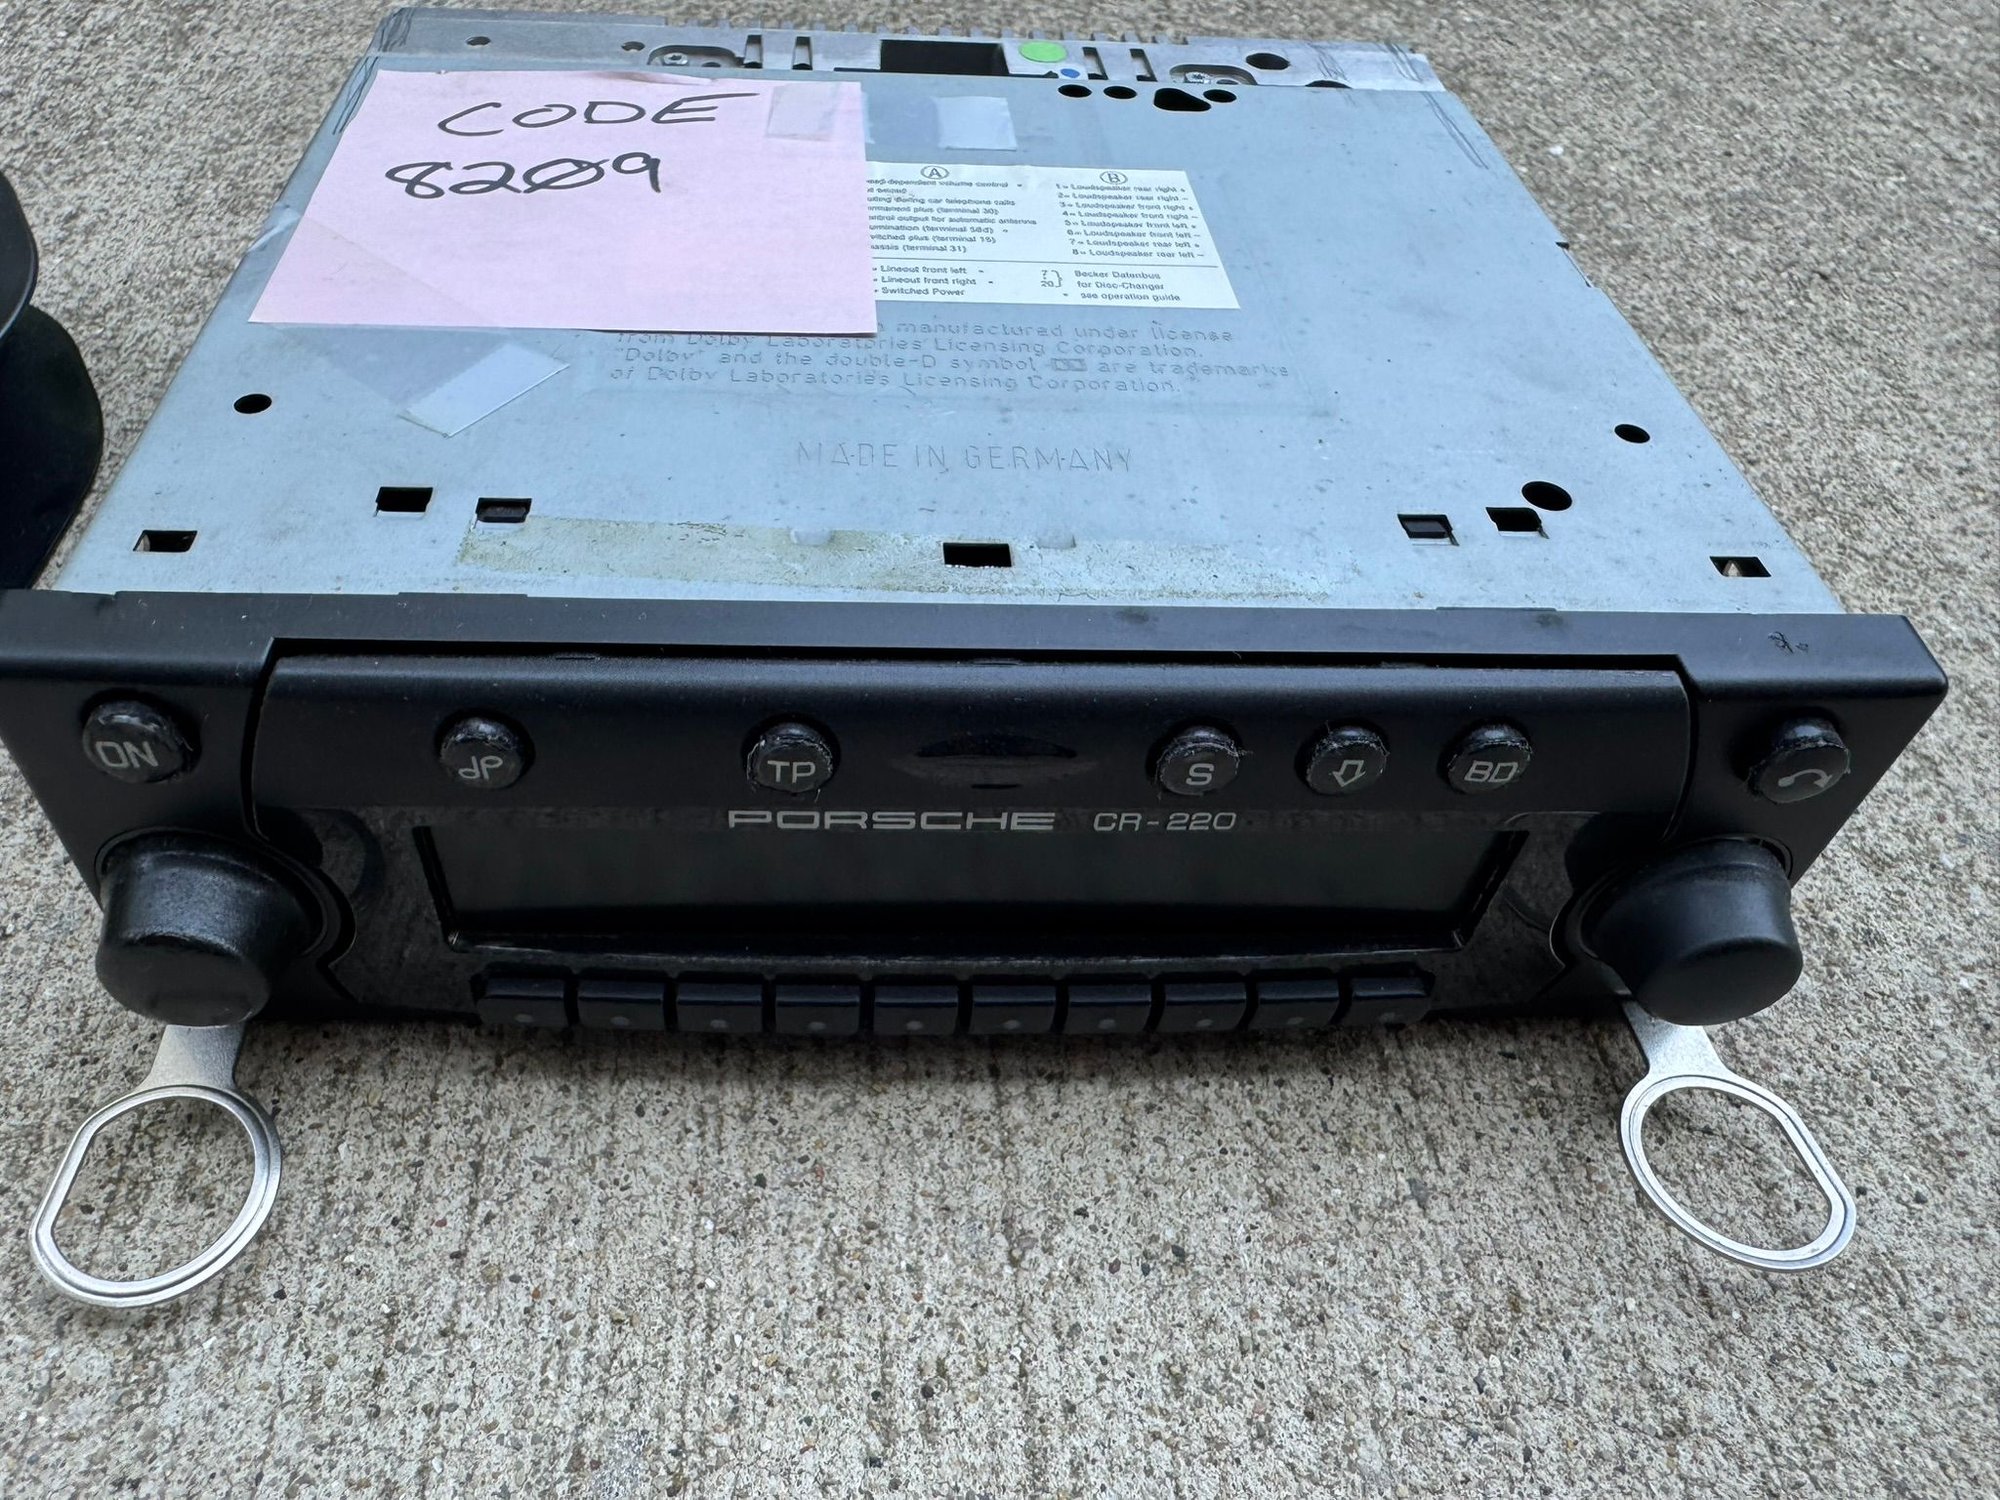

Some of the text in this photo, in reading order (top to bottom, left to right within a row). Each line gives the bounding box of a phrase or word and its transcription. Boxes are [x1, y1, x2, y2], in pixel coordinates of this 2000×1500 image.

[438, 93, 760, 137] CODE
[385, 152, 661, 199] 8209
[982, 207, 999, 215] 30)
[902, 244, 947, 252] (terminal
[949, 245, 967, 253] 31)
[880, 265, 919, 273] Lineout
[1074, 269, 1161, 279] Becker Datenbus
[881, 286, 965, 296] Switched Power
[951, 277, 977, 286] right
[1076, 280, 1164, 291] for Disc-Changer
[1100, 292, 1149, 301] operation
[1152, 293, 1180, 302] guide
[896, 321, 1063, 337] manufactured
[1074, 324, 1138, 339] under
[1151, 325, 1233, 342] license
[767, 336, 923, 350] Laboratories
[934, 337, 1045, 357] Licensing
[719, 351, 762, 364] and
[776, 351, 812, 365] the
[825, 353, 936, 369] double-D
[950, 356, 1036, 372] symbol
[1099, 361, 1137, 374] are
[1149, 361, 1289, 377] trademarks
[610, 366, 635, 380] of
[648, 366, 718, 382] Dolby
[730, 368, 890, 386] Laboratories
[903, 373, 1018, 392] Licensing
[798, 441, 1131, 472] MADE IN GERMANY
[95, 740, 159, 769] ON
[767, 760, 817, 784] TP
[1185, 763, 1215, 786] S
[1464, 760, 1519, 784] BD
[727, 810, 1237, 832] PORSCHE CR-220
